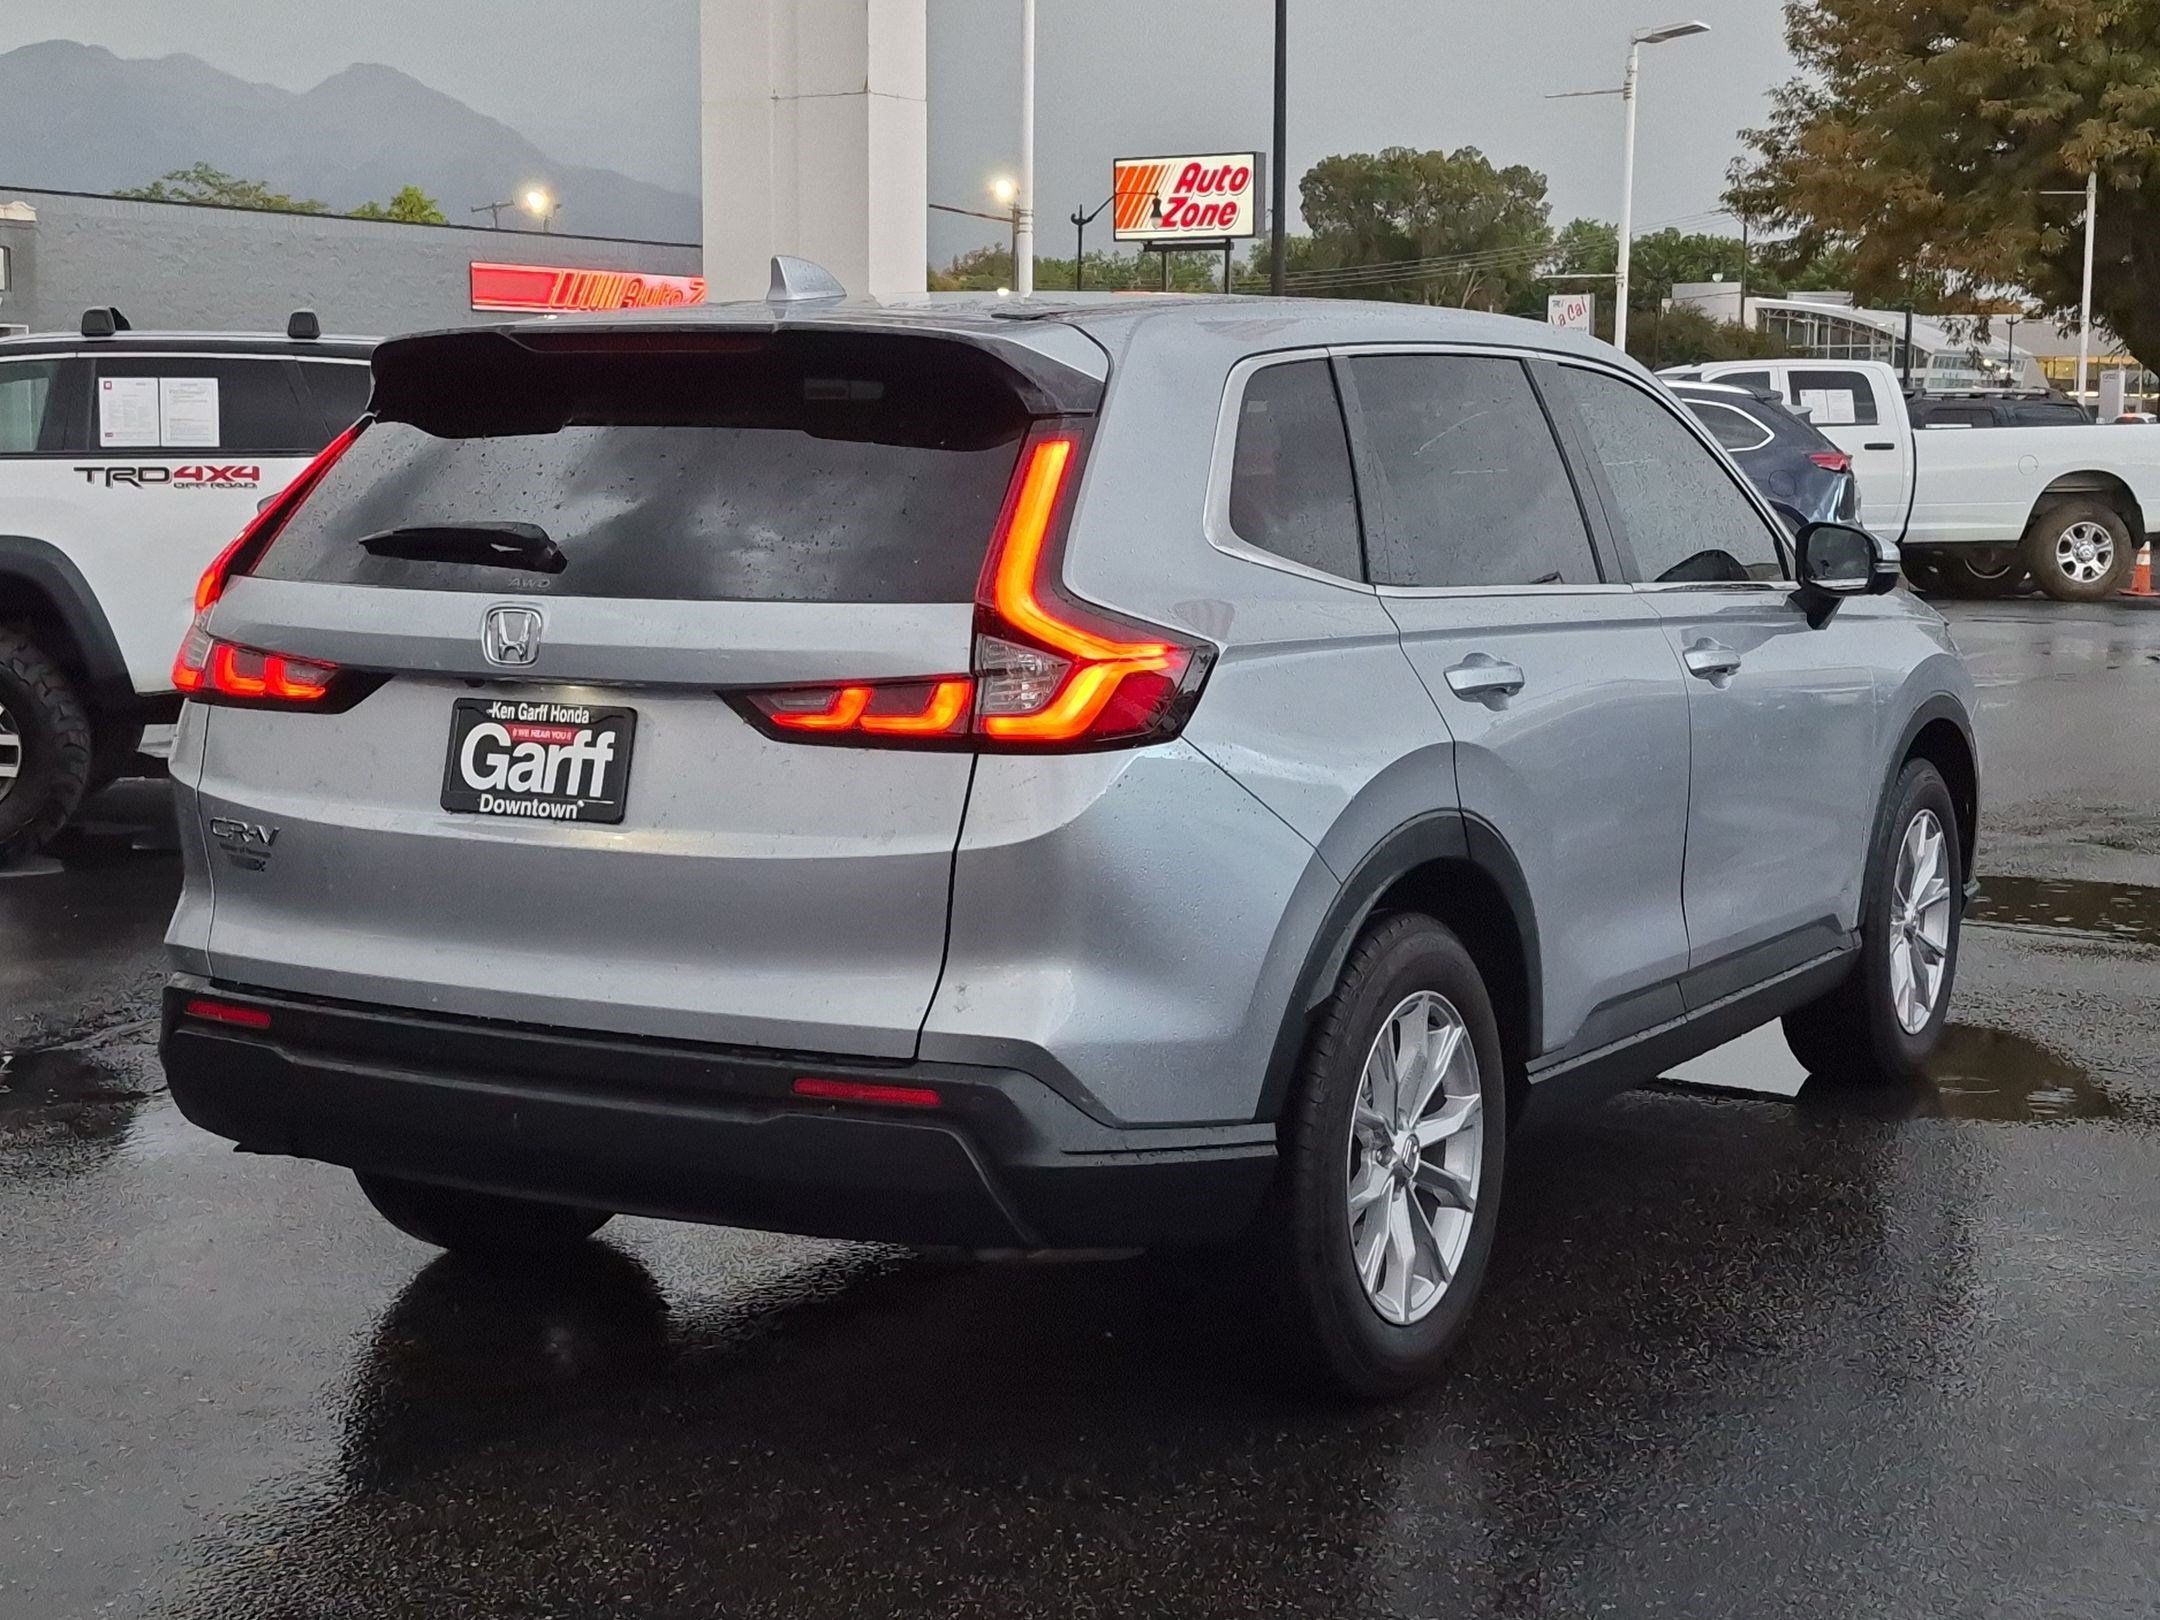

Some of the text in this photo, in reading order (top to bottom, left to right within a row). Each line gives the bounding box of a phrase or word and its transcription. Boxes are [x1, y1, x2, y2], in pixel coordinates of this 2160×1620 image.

[1173, 162, 1250, 195] Auto
[1161, 197, 1238, 228] Zone
[621, 277, 683, 308] Auto
[73, 466, 173, 489] TRD
[210, 482, 258, 490] ROAD
[507, 577, 552, 589] AWD
[491, 701, 590, 724] Ken Garff Honda
[460, 722, 616, 798] Garff
[479, 794, 578, 819] Downtown
[210, 816, 280, 846] CR-V
